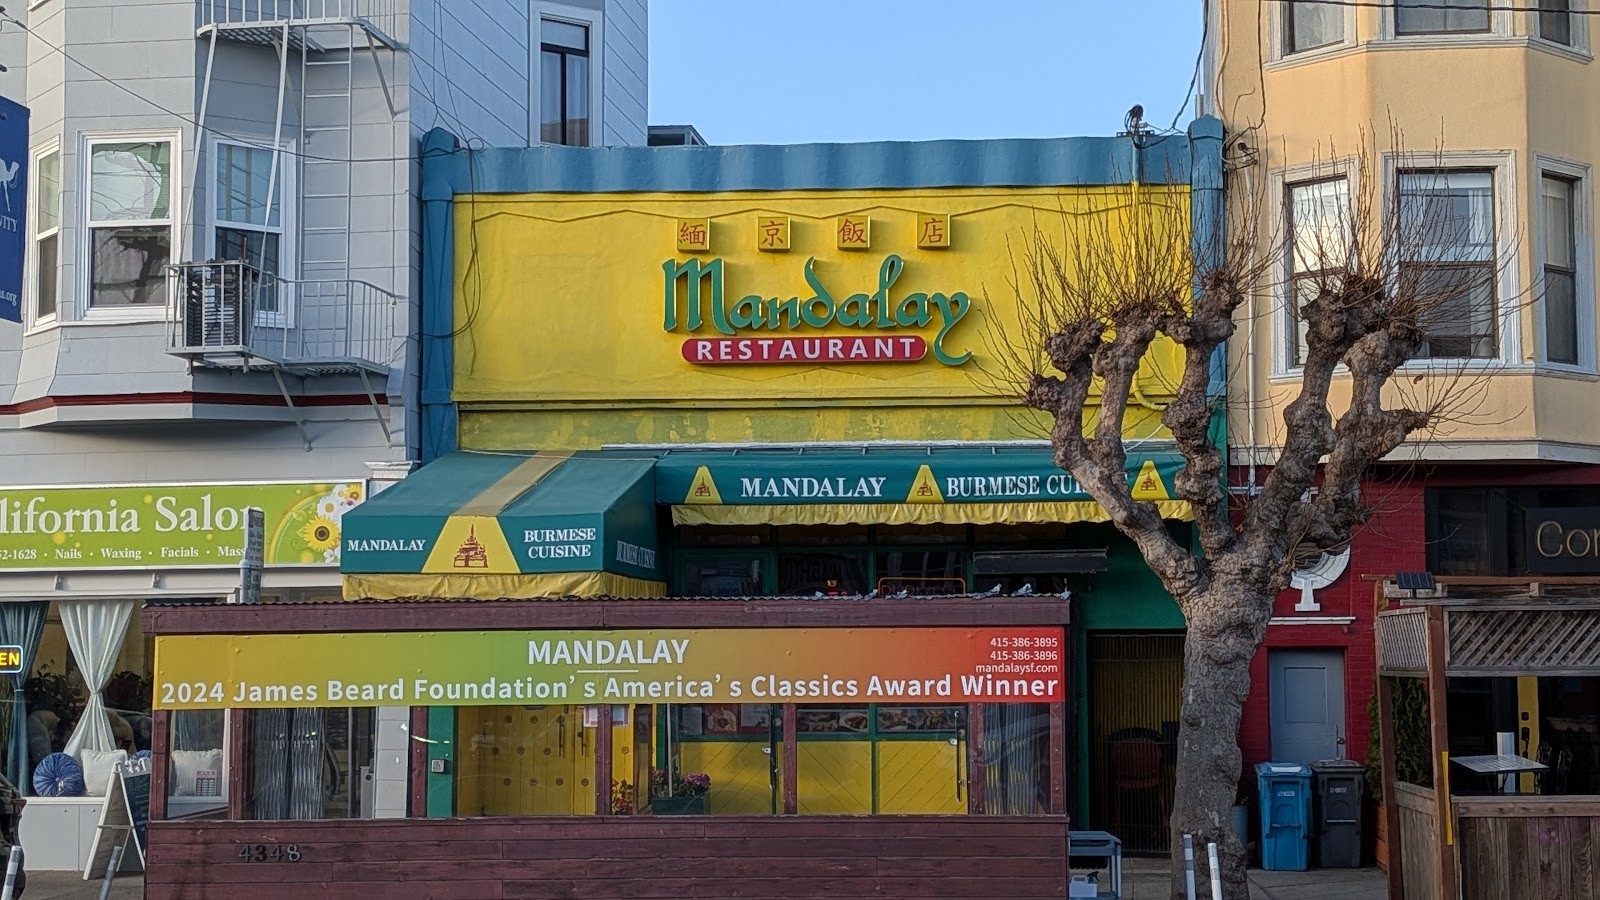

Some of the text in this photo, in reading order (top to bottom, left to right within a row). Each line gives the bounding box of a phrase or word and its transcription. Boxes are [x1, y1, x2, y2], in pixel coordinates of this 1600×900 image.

[661, 254, 973, 366] Mandalay
[696, 338, 916, 361] RESTAURANT
[740, 477, 886, 498] MANDALAY
[946, 476, 1040, 497] BURMESE
[523, 528, 596, 543] BURMESE
[55, 548, 82, 559] Nails
[101, 547, 142, 560] Waxing
[160, 546, 199, 558] Facials
[347, 539, 426, 552] MANDALAY
[528, 545, 592, 559] CUISINE
[990, 637, 1058, 648] 415-386-3895
[528, 639, 690, 665] MANDALAY
[990, 650, 1058, 661] 415-386-3896
[975, 662, 1058, 675] mandalaysf.com
[161, 681, 225, 704] 2024
[232, 681, 318, 703] James
[327, 678, 404, 701] Beard
[751, 674, 859, 698] Classics
[866, 674, 952, 697] Award
[960, 673, 1059, 697] Winner
[238, 843, 302, 863] 4348
